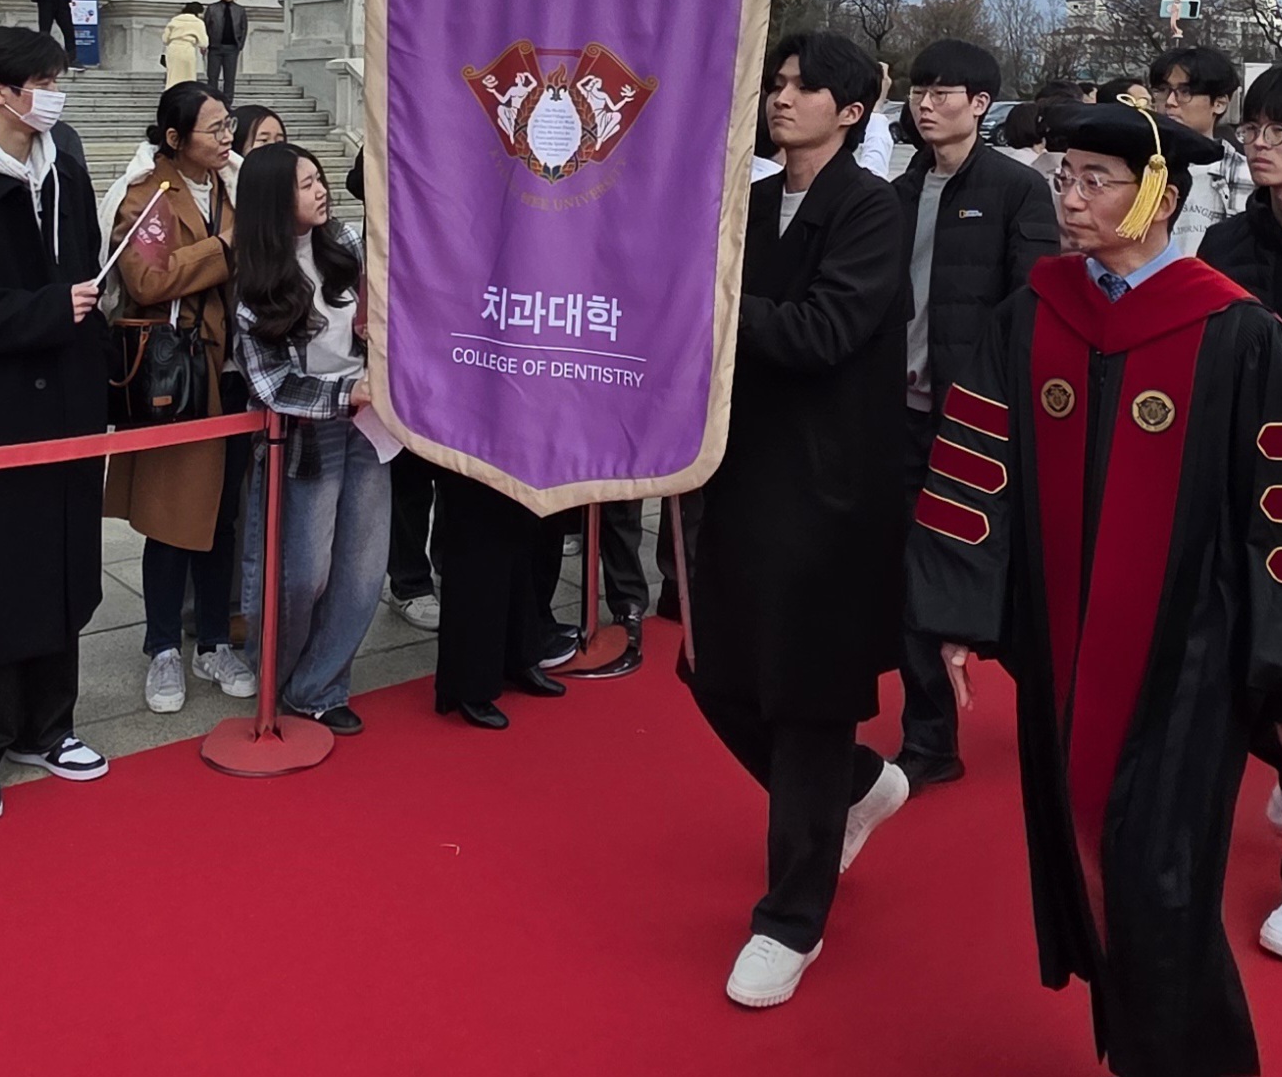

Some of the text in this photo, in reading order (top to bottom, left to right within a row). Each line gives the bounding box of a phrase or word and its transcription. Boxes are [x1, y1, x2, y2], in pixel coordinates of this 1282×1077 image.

[481, 285, 623, 342] 치과대학
[452, 347, 645, 388] COLLEGE OF DENTISTRY
